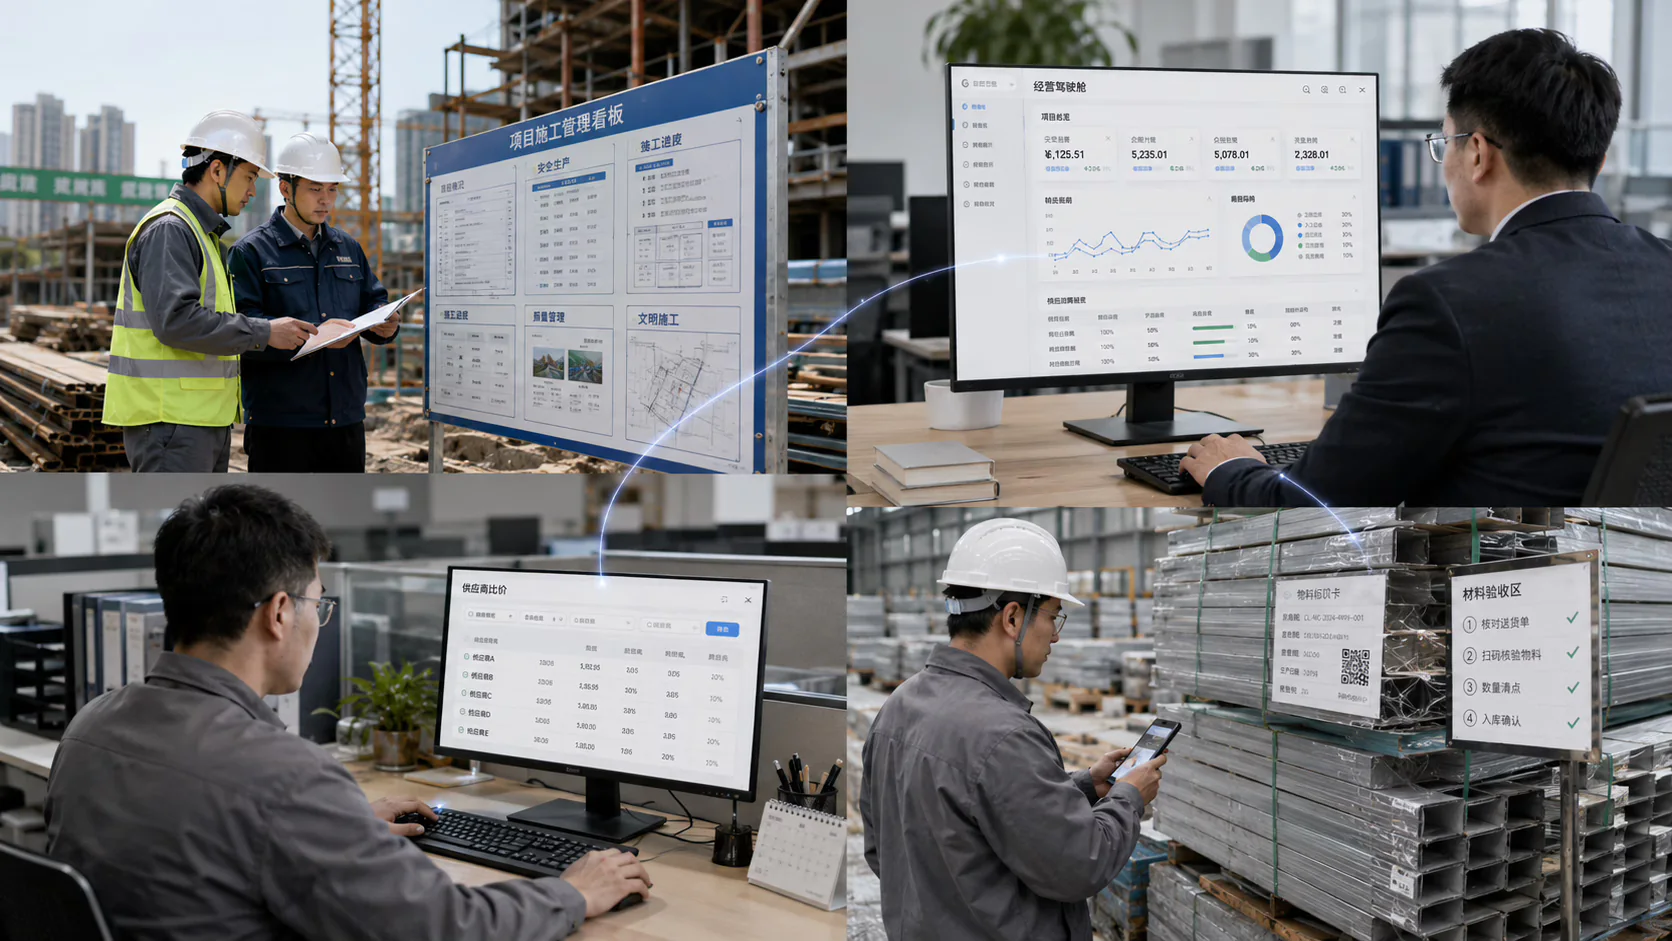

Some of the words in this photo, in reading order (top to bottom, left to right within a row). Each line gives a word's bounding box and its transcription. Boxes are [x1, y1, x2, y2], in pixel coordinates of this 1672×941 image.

[1033, 80, 1087, 93] 经营驾驶舱
[509, 103, 624, 150] 项目施工管理看板
[1131, 150, 1168, 160] 5,235.01
[1214, 150, 1249, 160] 5,078.01
[1294, 150, 1329, 160] 2,328.01
[638, 312, 680, 326] 文明施工
[462, 583, 508, 595] 供应商比价
[1462, 582, 1522, 602] 材料验收区
[1481, 616, 1530, 630] 核对送货单
[1482, 648, 1542, 662] 扫码核验物料
[1482, 682, 1521, 694] 数量清点
[1482, 714, 1522, 727] 入库确认
